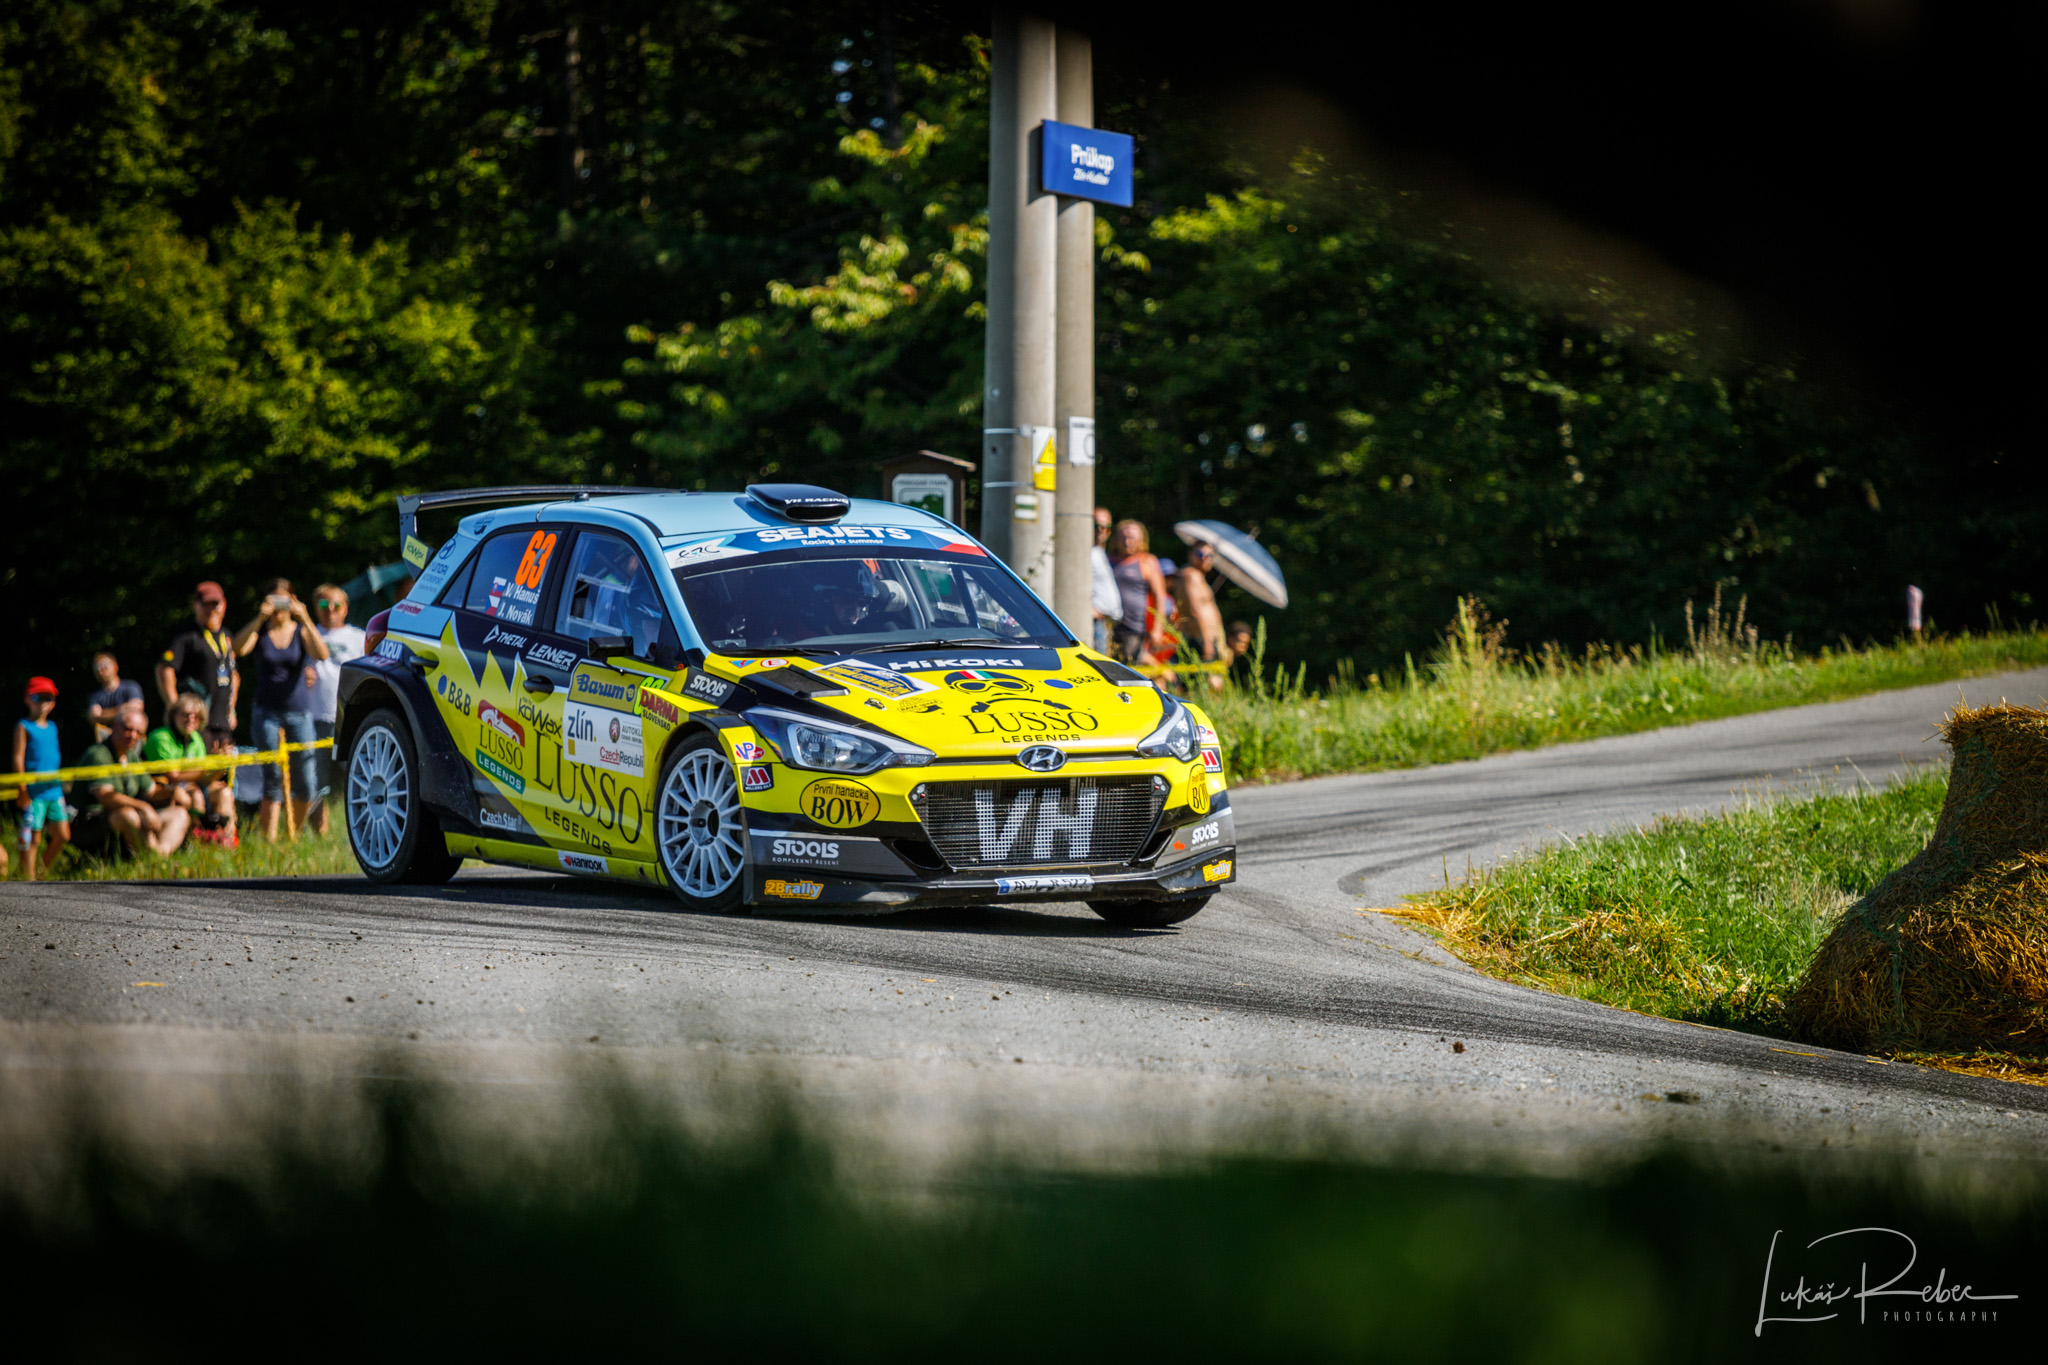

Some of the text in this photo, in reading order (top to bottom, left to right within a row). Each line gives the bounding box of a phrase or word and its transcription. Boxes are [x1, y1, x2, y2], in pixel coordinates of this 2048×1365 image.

[757, 526, 912, 542] SEAJETS
[801, 538, 835, 546] Racing
[515, 529, 557, 590] 63
[504, 582, 540, 605] V. Hanuš
[497, 601, 533, 625] J. Novák
[448, 681, 472, 716] B&B
[575, 673, 624, 700] Barum
[643, 709, 670, 732] SLOVENSKO
[959, 711, 1099, 735] LUSSO
[480, 724, 523, 771] LUSSO
[735, 742, 755, 760] VP
[1001, 734, 1081, 744] LEGENDS
[478, 754, 522, 791] LEGENDS
[533, 729, 643, 844] LUSSO
[813, 783, 870, 800] První hanácká
[479, 807, 503, 825] Czech
[811, 795, 870, 825] BOW
[544, 806, 613, 855] LEGENDS
[974, 787, 1098, 861] VH
[772, 839, 840, 859] STOOLS
